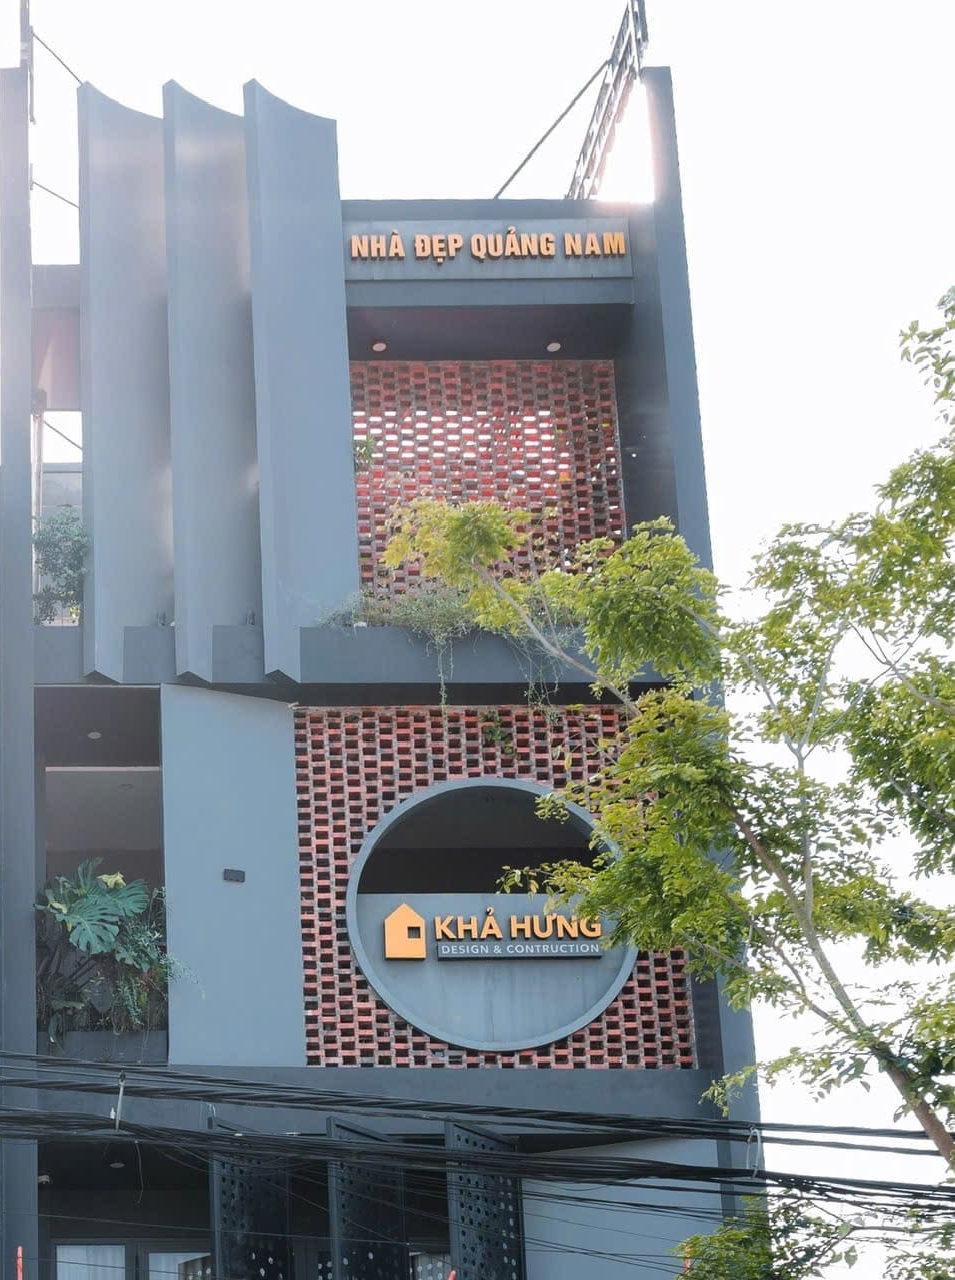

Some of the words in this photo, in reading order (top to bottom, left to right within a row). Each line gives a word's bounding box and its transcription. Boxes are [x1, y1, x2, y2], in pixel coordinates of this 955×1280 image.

[351, 229, 405, 258] NHÀ
[414, 234, 464, 264] ĐẸP
[470, 226, 555, 262] QUẢNG
[564, 232, 626, 257] NAM
[435, 907, 503, 940] KHẢ
[510, 912, 602, 939] HƯNG
[441, 945, 489, 954] DESIGN
[493, 944, 502, 954] &
[506, 943, 599, 954] CONTRUCTION
